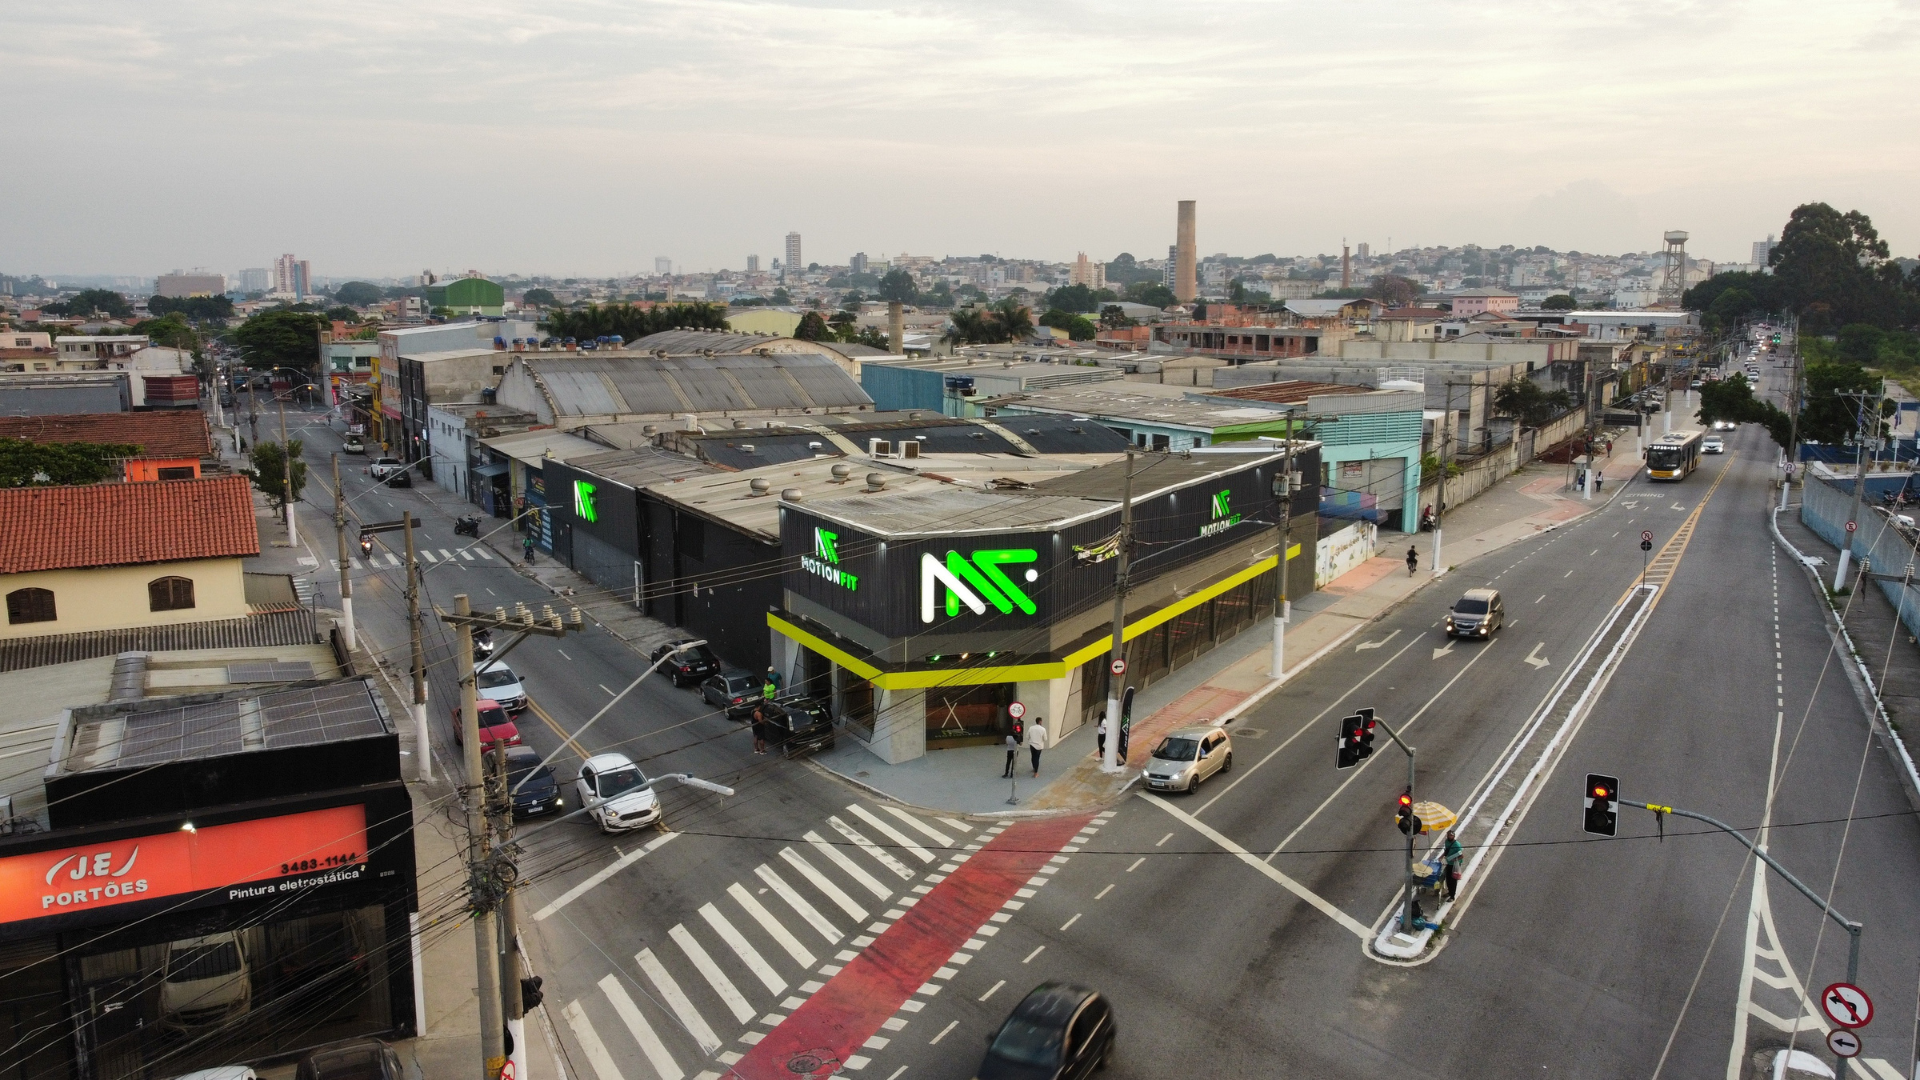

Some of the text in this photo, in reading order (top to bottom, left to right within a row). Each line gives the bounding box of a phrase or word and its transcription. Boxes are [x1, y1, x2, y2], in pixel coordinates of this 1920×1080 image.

[1200, 513, 1242, 538] MOTIONFIT
[801, 555, 859, 592] MOTIONFIT
[281, 852, 358, 874] 3483-1144
[42, 879, 149, 909] PORTÕES
[229, 884, 275, 900] Pintura
[279, 869, 360, 892] eletrostática
